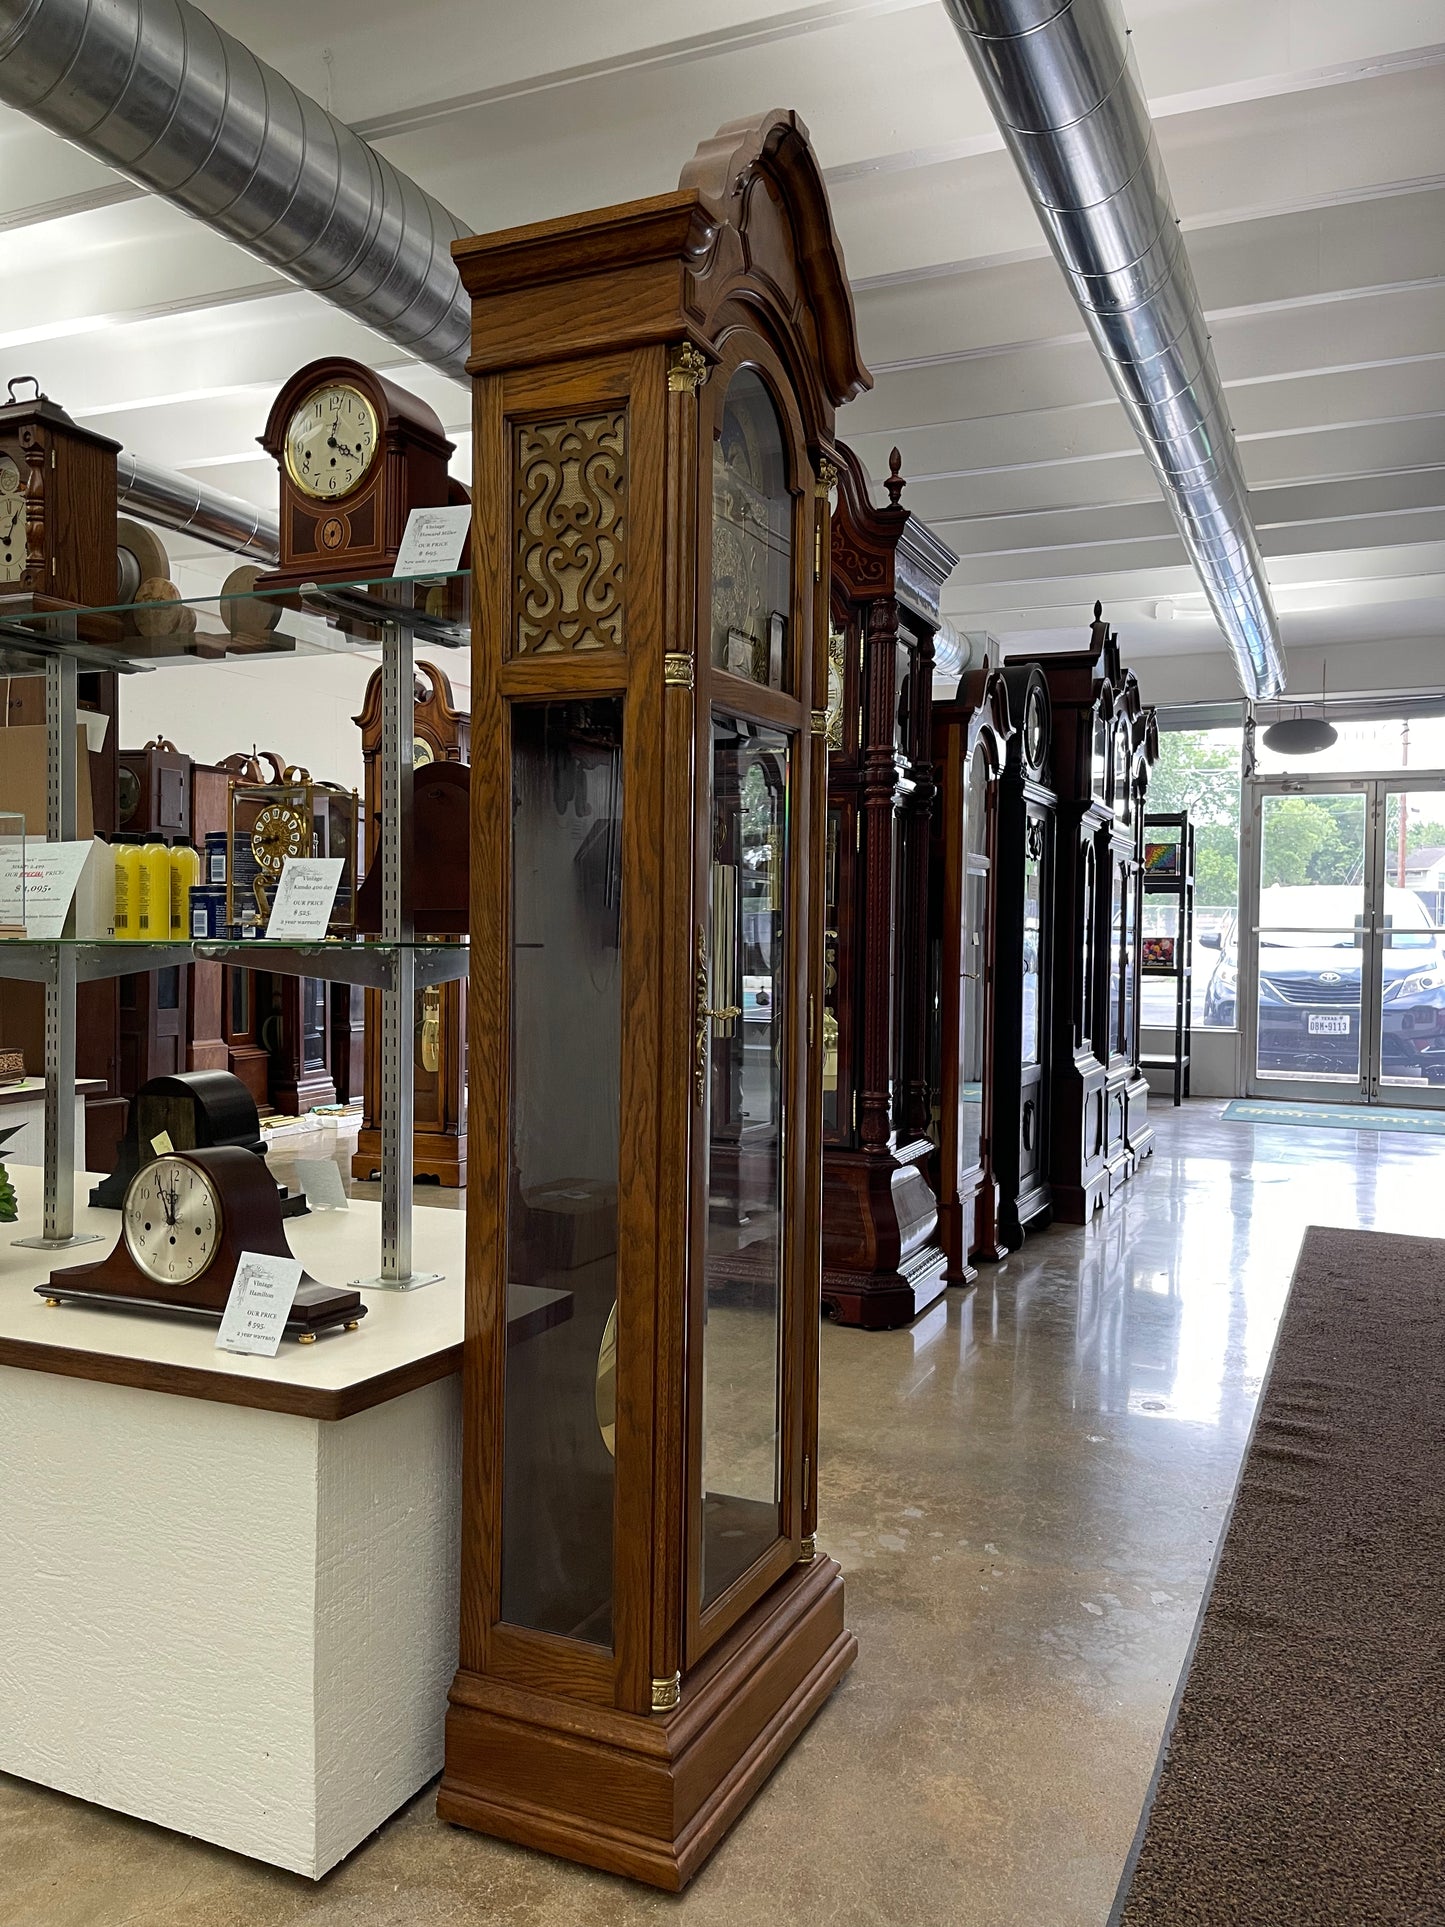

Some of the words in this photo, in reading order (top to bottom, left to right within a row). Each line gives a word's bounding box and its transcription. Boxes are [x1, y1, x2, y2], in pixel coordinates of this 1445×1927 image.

[315, 404, 322, 418] 11
[363, 431, 371, 446] 3
[302, 459, 310, 475] 8
[313, 472, 321, 487] 7
[345, 468, 352, 483] 5
[329, 475, 336, 490] 6
[140, 1188, 150, 1200] 10
[202, 1194, 208, 1206] 2
[135, 1211, 141, 1222] 9
[206, 1218, 212, 1230] 3
[139, 1235, 146, 1247] 8
[200, 1242, 206, 1253] 4
[152, 1252, 158, 1264] 7
[187, 1257, 193, 1269] 5
[168, 1260, 175, 1272] 6
[253, 1280, 274, 1289] Vintage
[249, 1289, 275, 1299] Hamilton
[246, 1309, 259, 1317] OUR
[260, 1311, 278, 1319] PRICE
[253, 1333, 276, 1342] warranty
